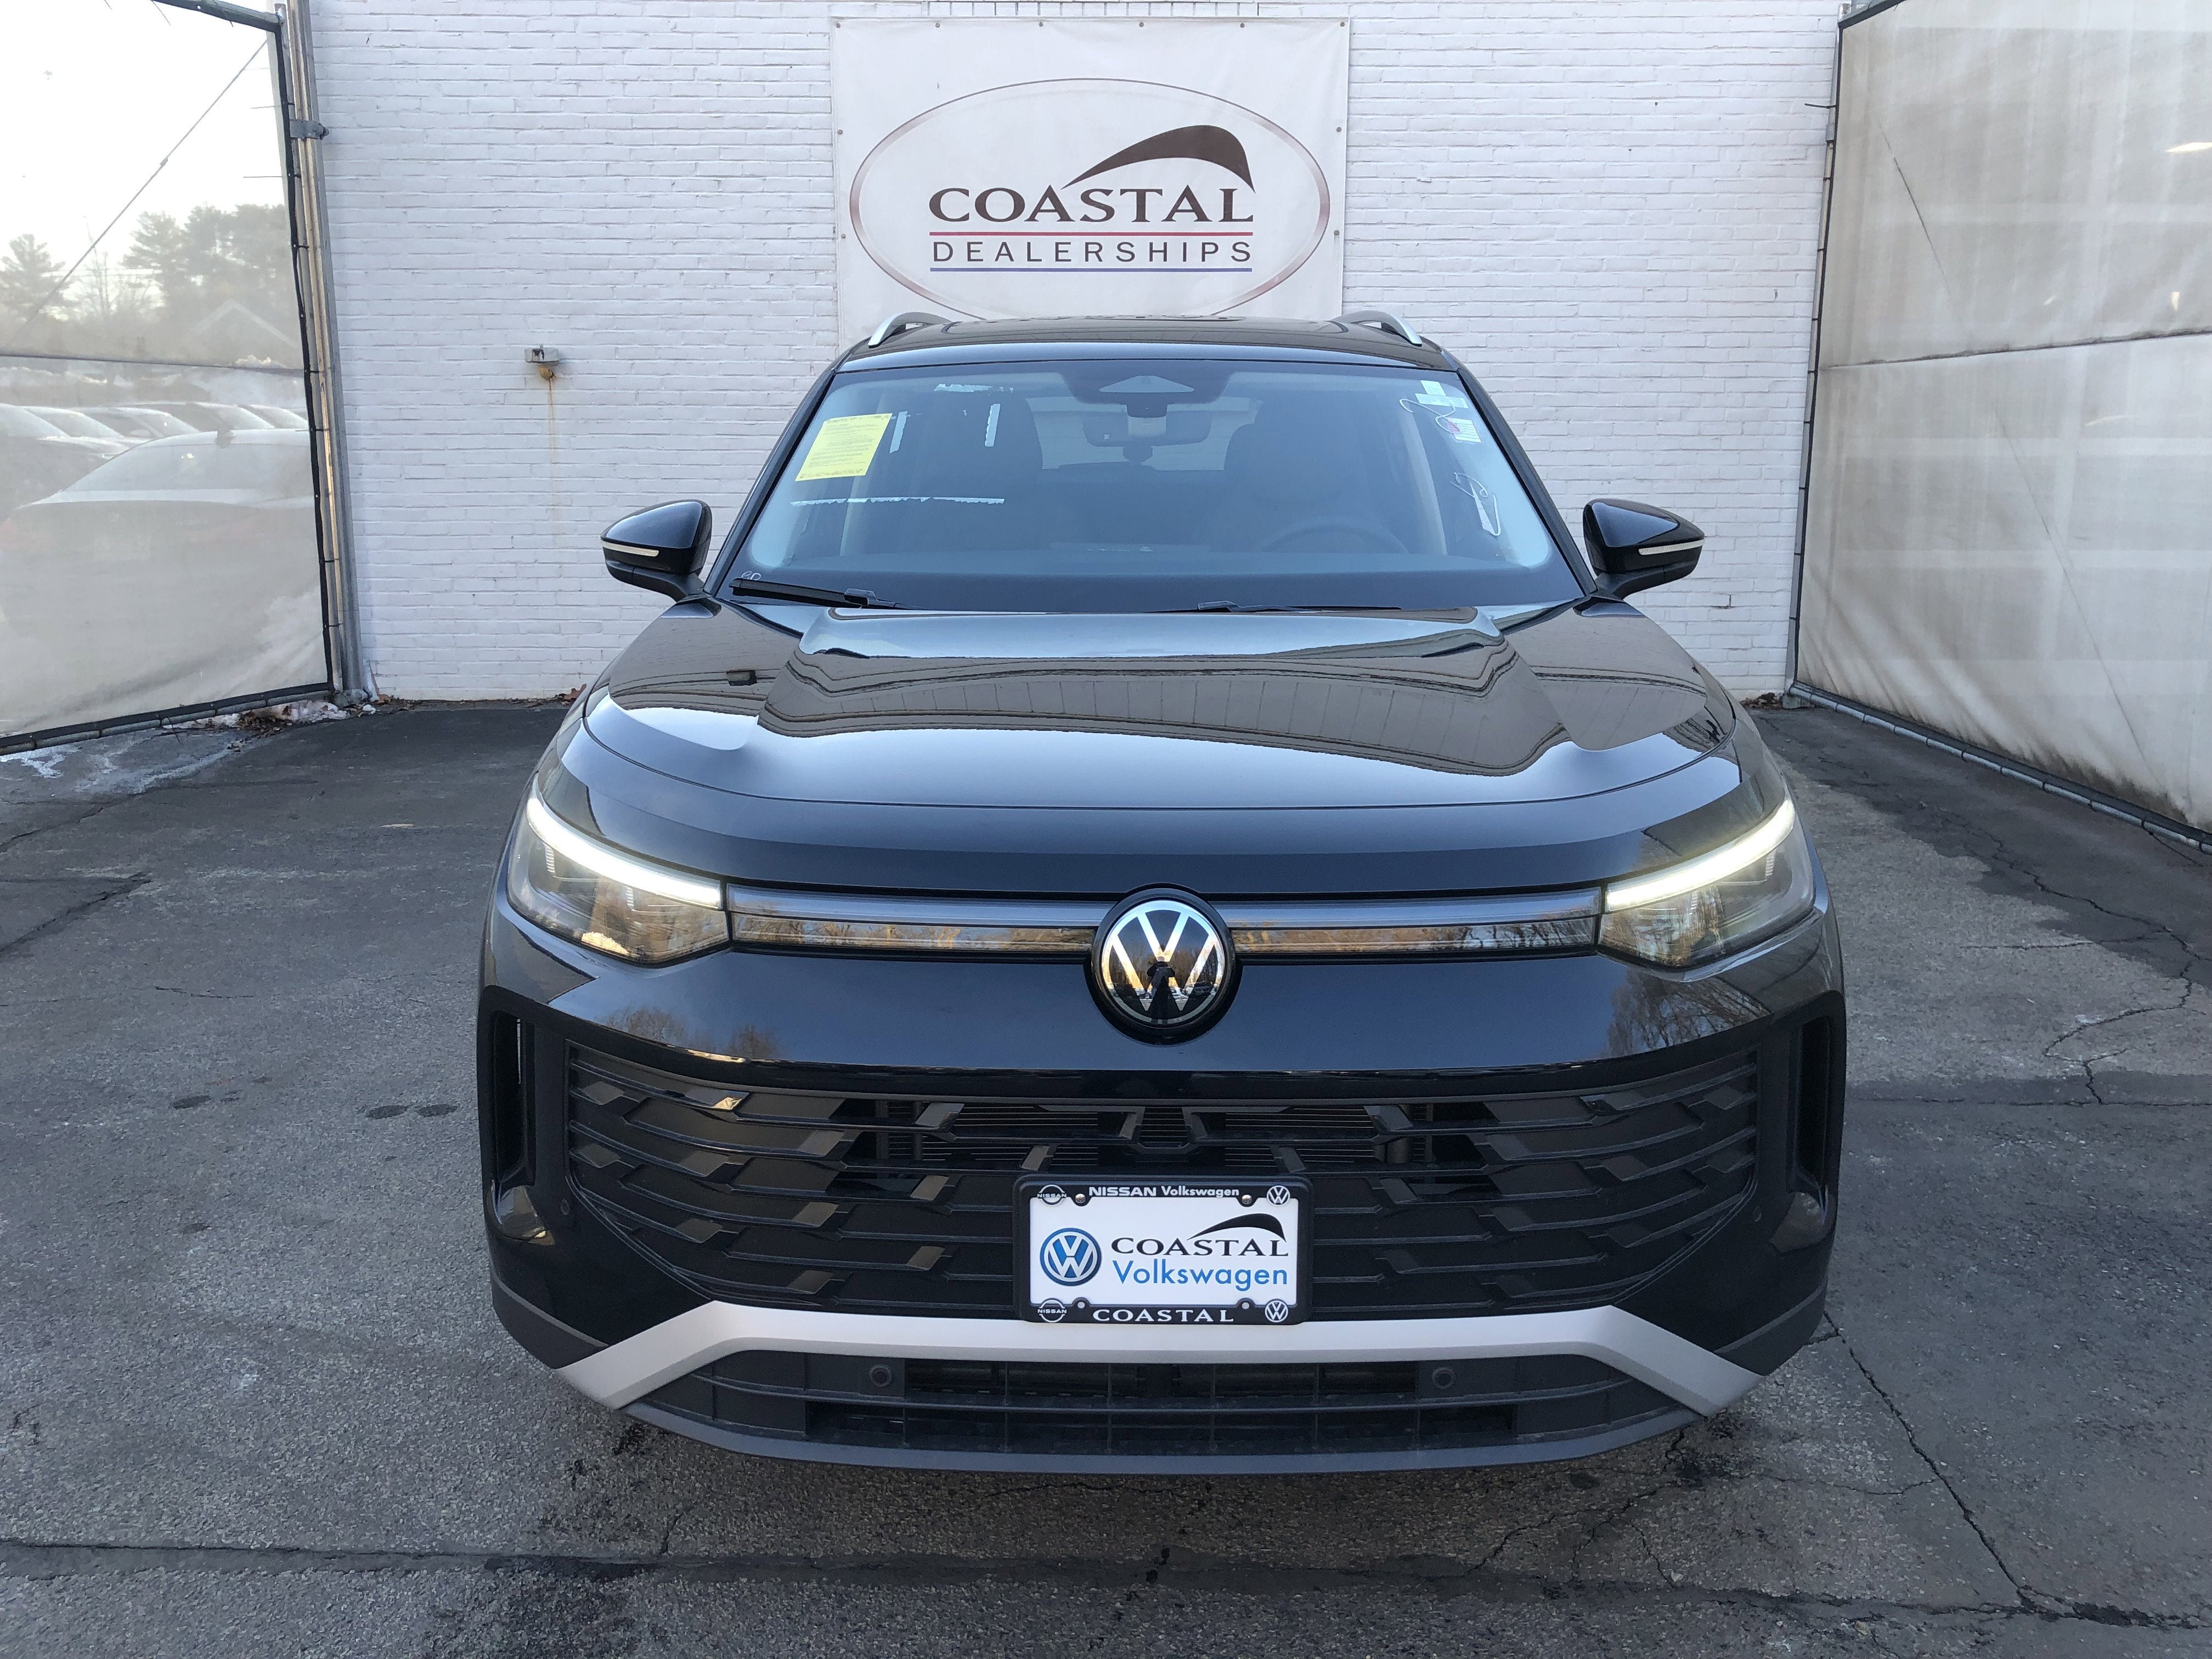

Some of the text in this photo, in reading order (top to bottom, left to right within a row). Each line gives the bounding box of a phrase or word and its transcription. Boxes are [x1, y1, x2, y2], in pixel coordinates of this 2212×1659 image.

[929, 184, 1254, 222] COASTAL
[933, 241, 1251, 262] DEALERSHIPS
[1089, 1186, 1240, 1198] NISSAN Volkswagen
[1111, 1238, 1289, 1256] COASTAL
[1112, 1259, 1287, 1291] Volkswagen
[1093, 1309, 1234, 1322] COASTAL
